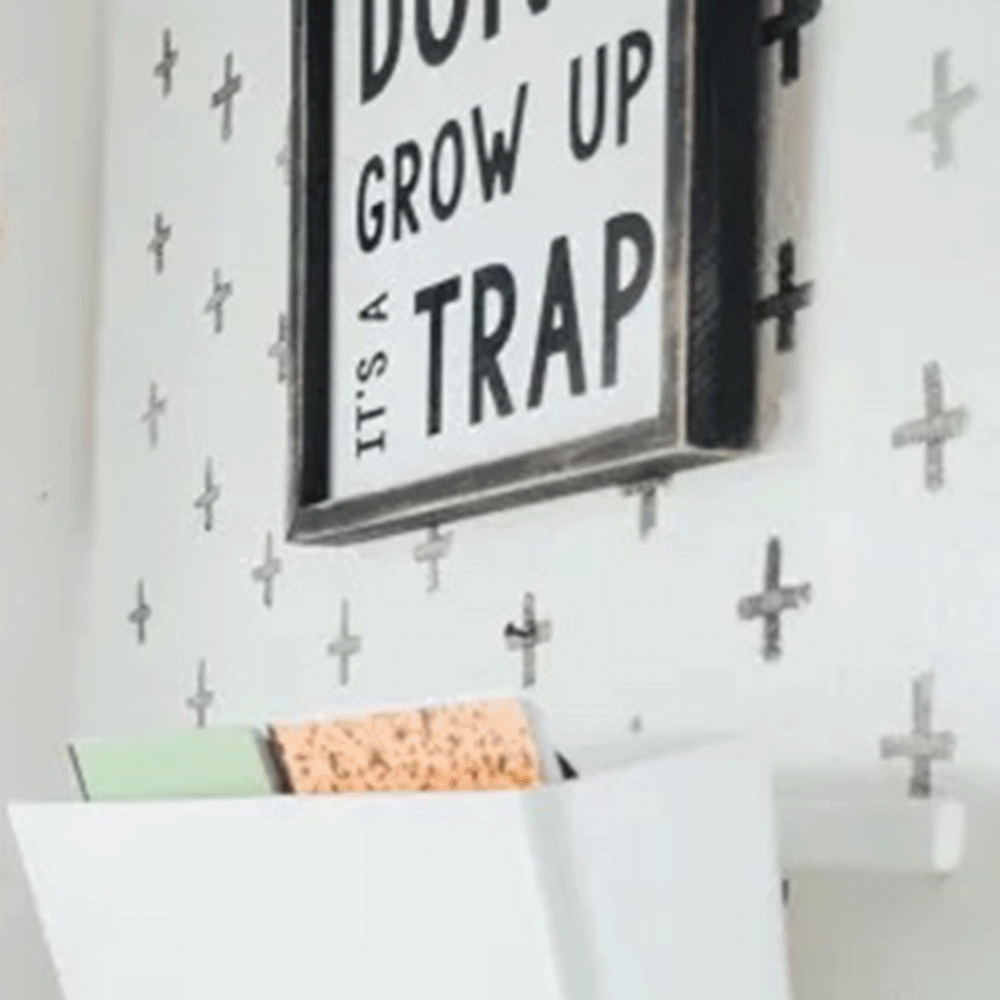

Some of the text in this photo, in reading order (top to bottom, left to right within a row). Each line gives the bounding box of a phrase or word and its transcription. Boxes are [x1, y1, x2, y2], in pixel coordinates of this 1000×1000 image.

[356, 81, 529, 254] GROW
[568, 29, 654, 162] UP
[355, 292, 389, 459] IT'S A
[413, 211, 656, 438] TRAP
